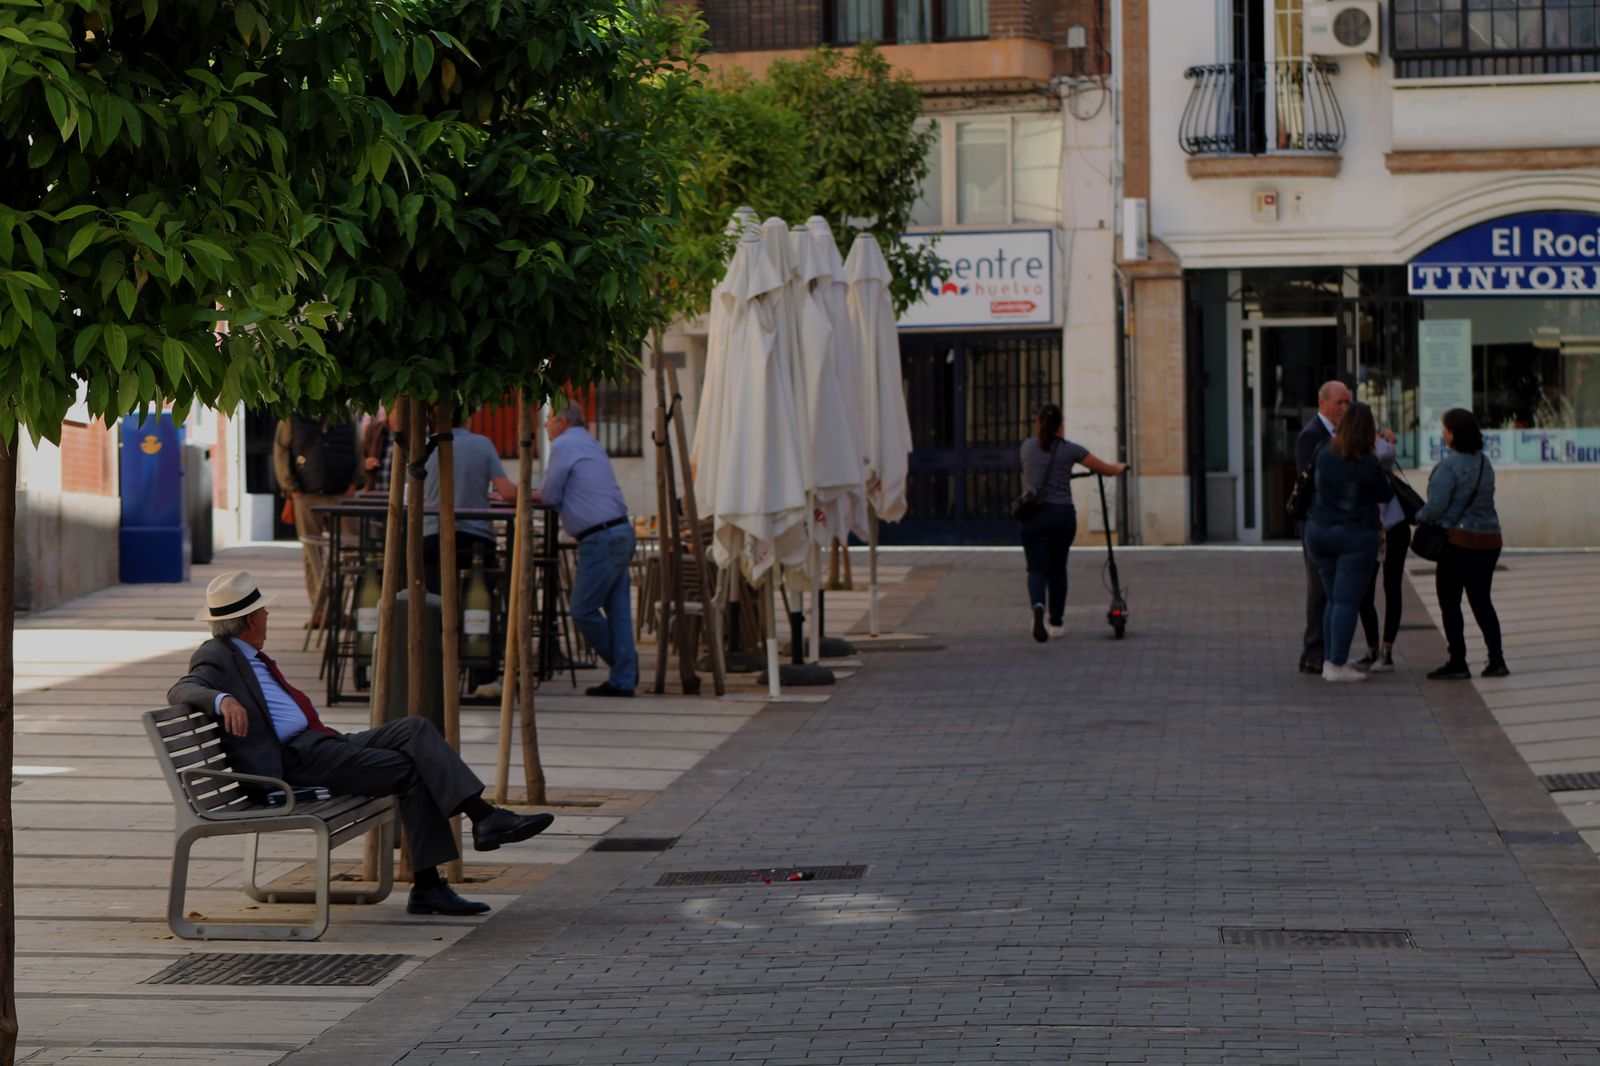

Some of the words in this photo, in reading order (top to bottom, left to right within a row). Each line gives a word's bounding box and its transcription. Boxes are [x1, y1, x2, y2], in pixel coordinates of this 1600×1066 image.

[1493, 227, 1519, 256] El
[975, 282, 1042, 296] huelva
[1566, 441, 1600, 462] ROCI
